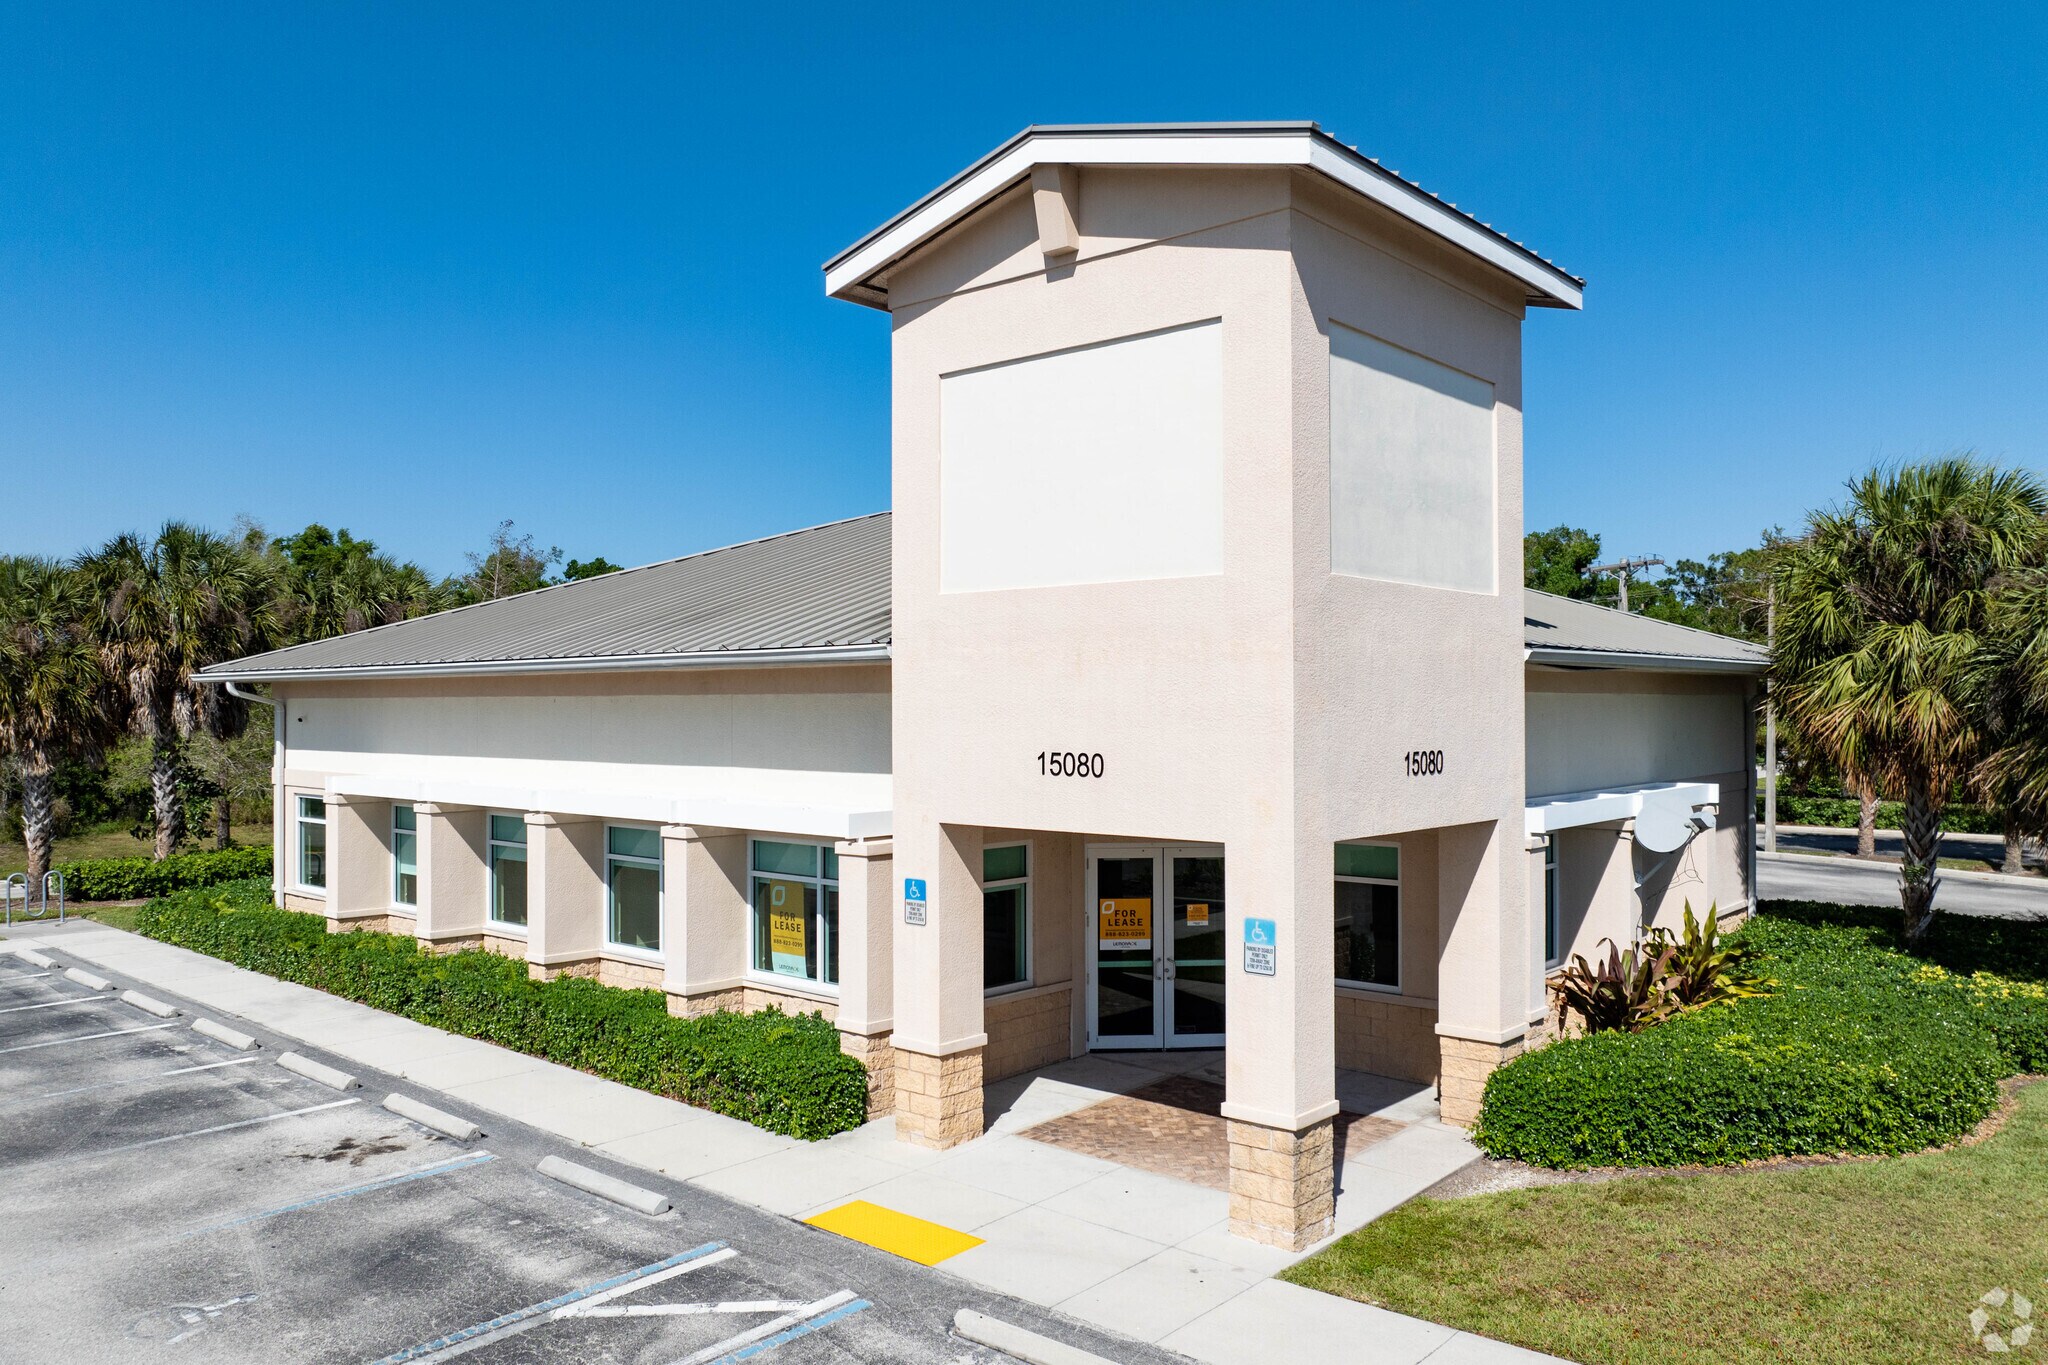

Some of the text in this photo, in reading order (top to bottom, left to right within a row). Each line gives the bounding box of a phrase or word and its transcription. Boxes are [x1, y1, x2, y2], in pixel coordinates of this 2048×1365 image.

[1037, 751, 1104, 778] 15080
[1404, 750, 1444, 777] 15080
[779, 911, 796, 922] FOR
[1114, 909, 1136, 918] FOR
[774, 920, 801, 933] LEASE
[1108, 918, 1143, 927] LEASE
